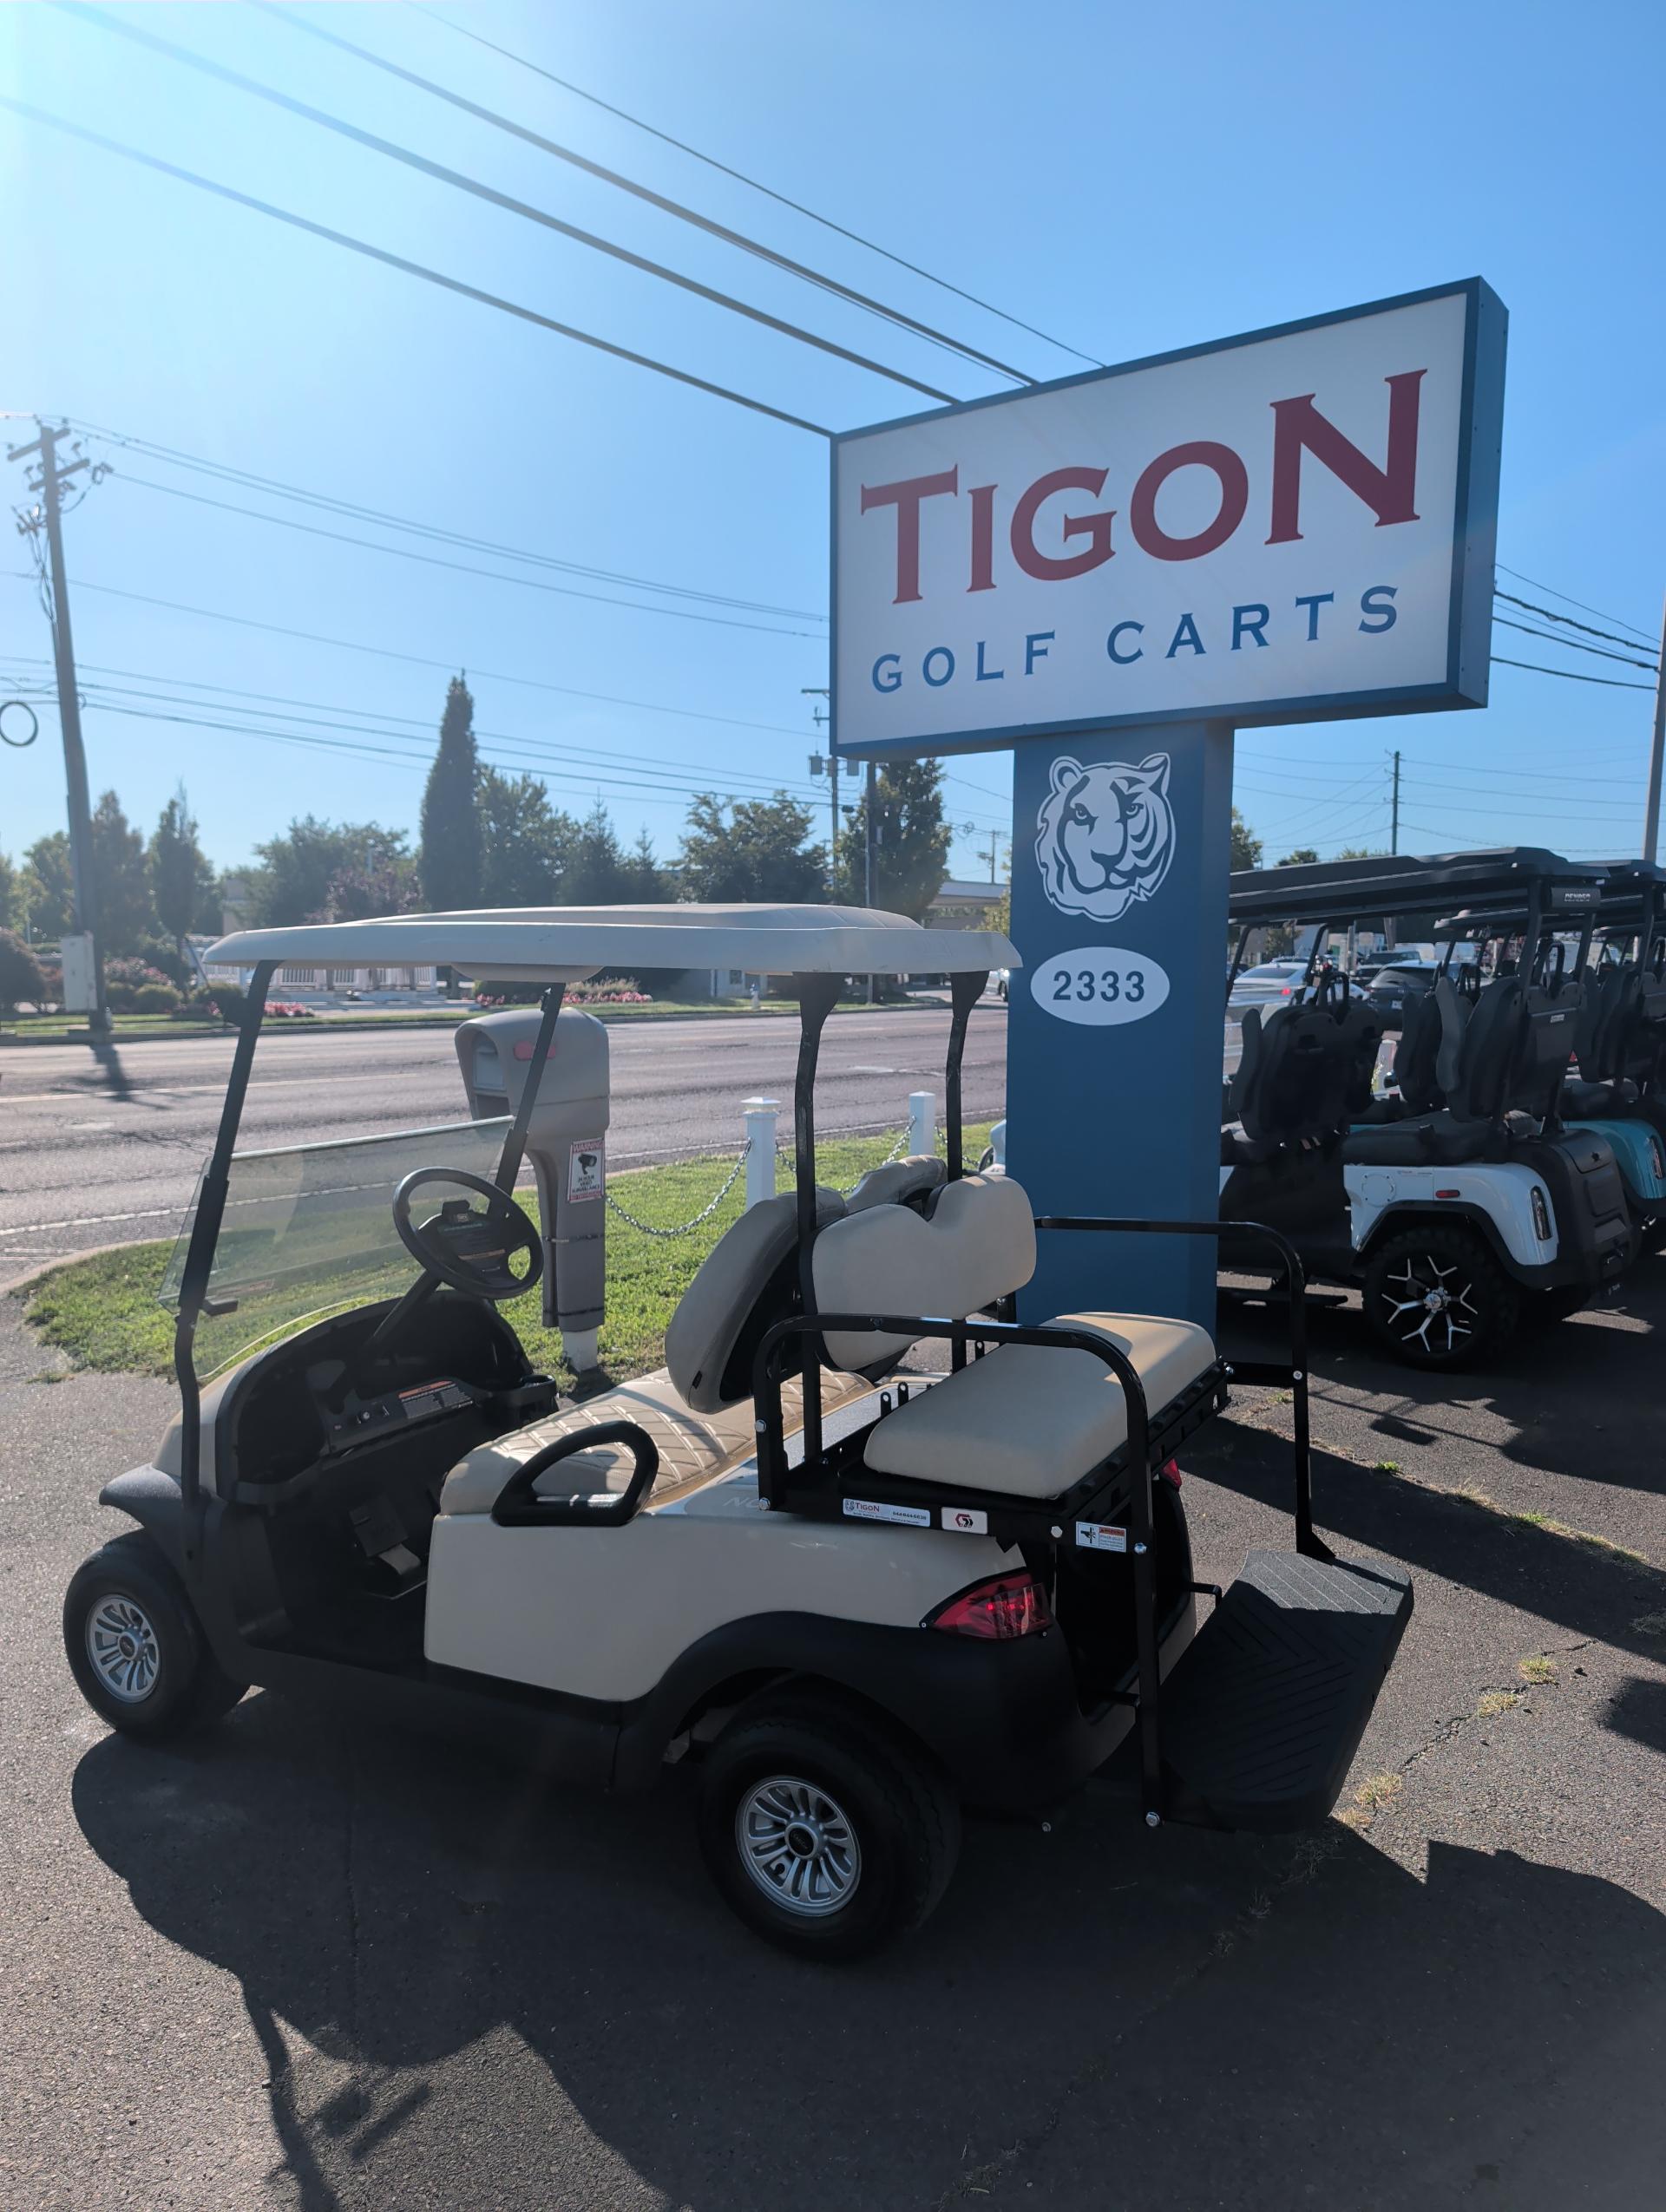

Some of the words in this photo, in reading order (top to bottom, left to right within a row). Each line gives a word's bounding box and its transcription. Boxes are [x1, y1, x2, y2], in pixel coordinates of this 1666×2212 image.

[861, 369, 1427, 605] TIGON
[872, 629, 1055, 693] GOLF
[1107, 586, 1398, 664] CARTS
[1053, 970, 1145, 1003] 2333
[855, 1502, 880, 1513] TIGON
